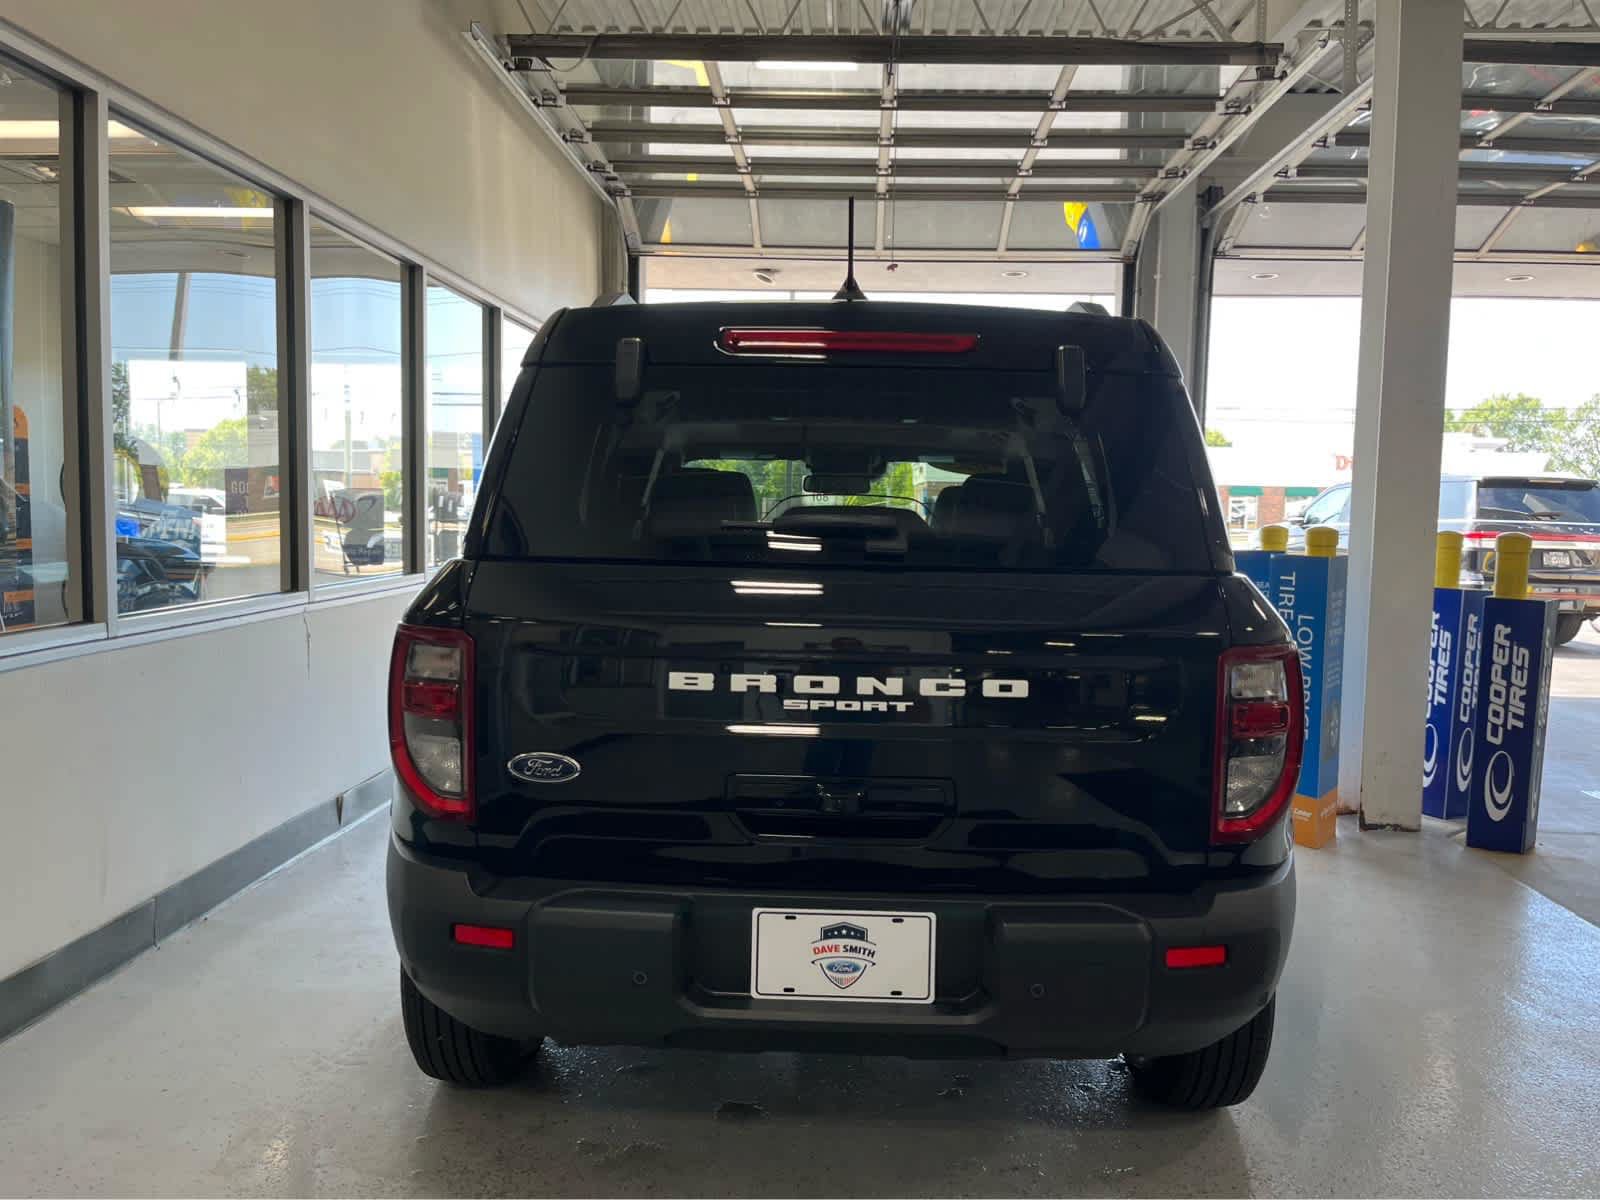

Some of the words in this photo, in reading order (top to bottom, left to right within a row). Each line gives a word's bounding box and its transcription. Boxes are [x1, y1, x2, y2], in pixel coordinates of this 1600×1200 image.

[1278, 571, 1296, 621] TIRE
[1296, 614, 1316, 670] LOW
[1433, 628, 1452, 706] TIRES
[1460, 613, 1478, 723] COOPER
[668, 671, 1029, 698] BRONCO
[783, 699, 914, 712] SPORT
[1486, 623, 1511, 746] COOPER
[1507, 645, 1530, 731] TIRES
[524, 758, 563, 777] Ford
[812, 944, 841, 956] DAVE
[842, 944, 876, 958] SMITH
